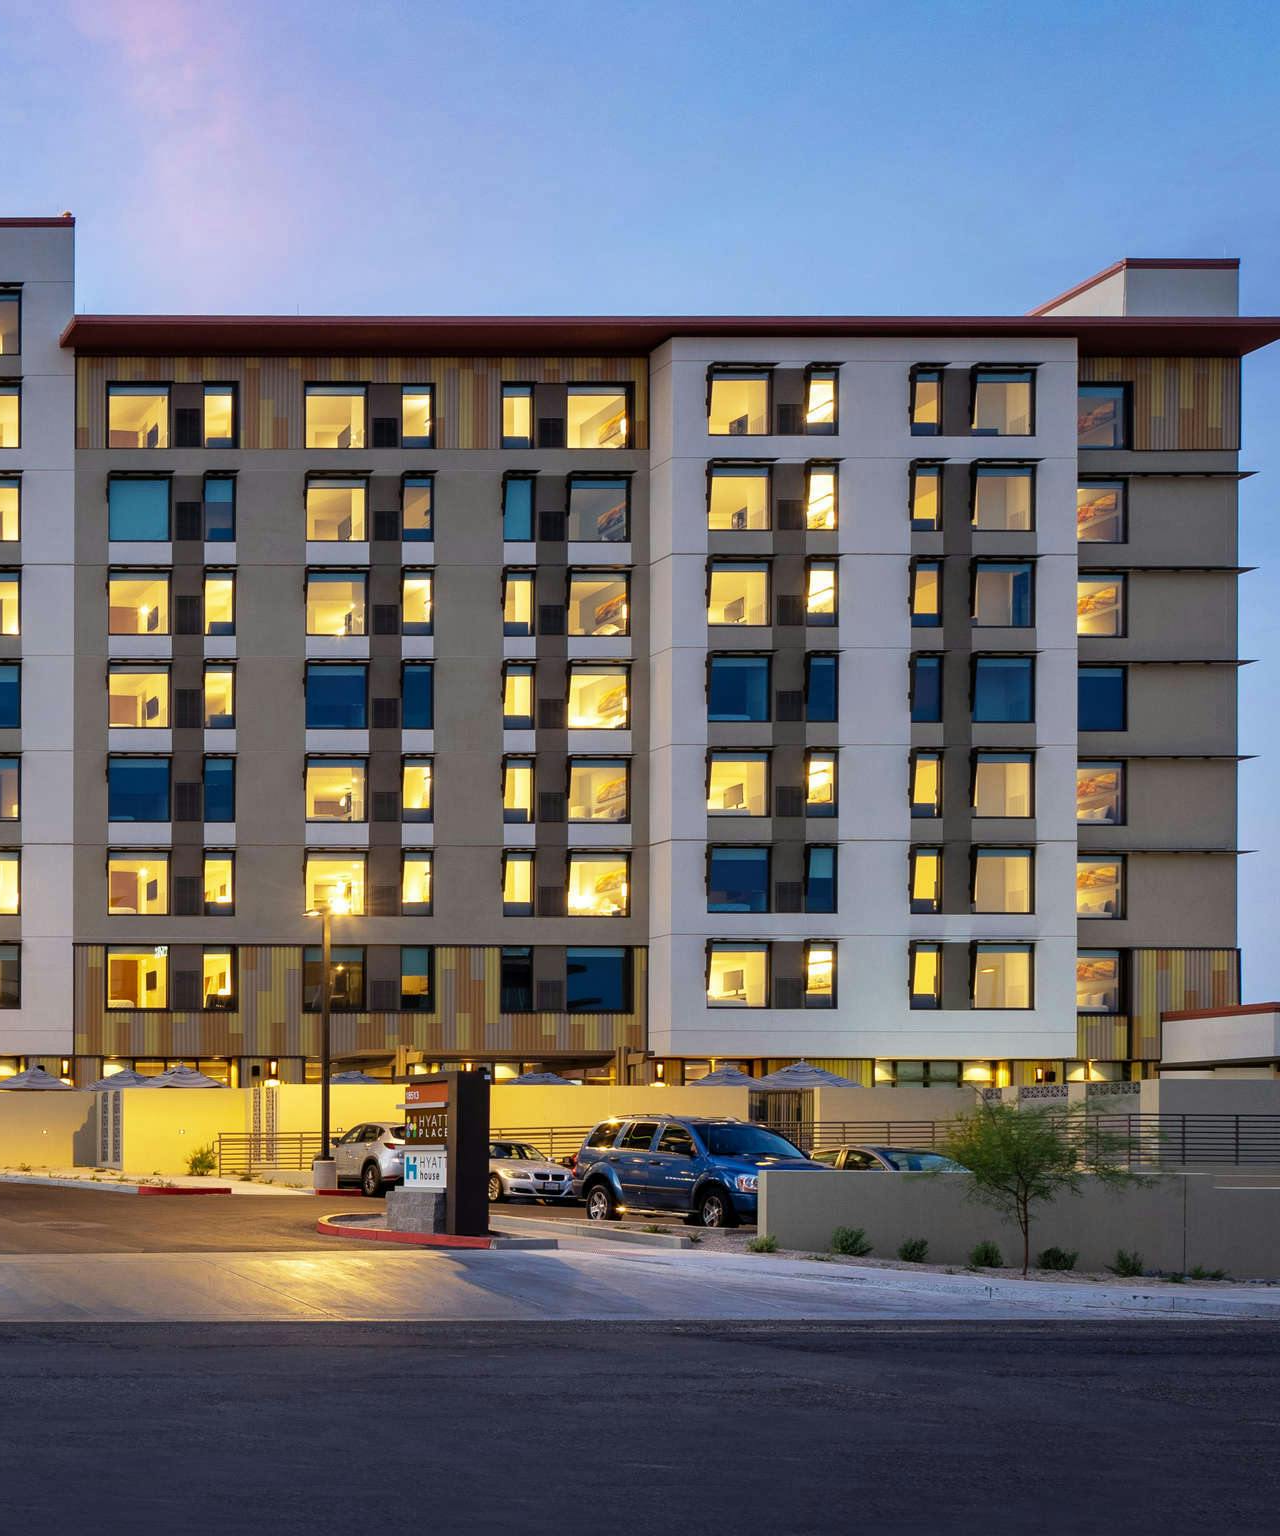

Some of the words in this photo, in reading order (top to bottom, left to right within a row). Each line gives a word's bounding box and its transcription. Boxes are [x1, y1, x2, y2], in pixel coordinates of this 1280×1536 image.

[419, 1115, 448, 1128] HYATT
[419, 1128, 448, 1138] PLACE
[420, 1156, 448, 1169] HYATT
[420, 1171, 440, 1181] house
